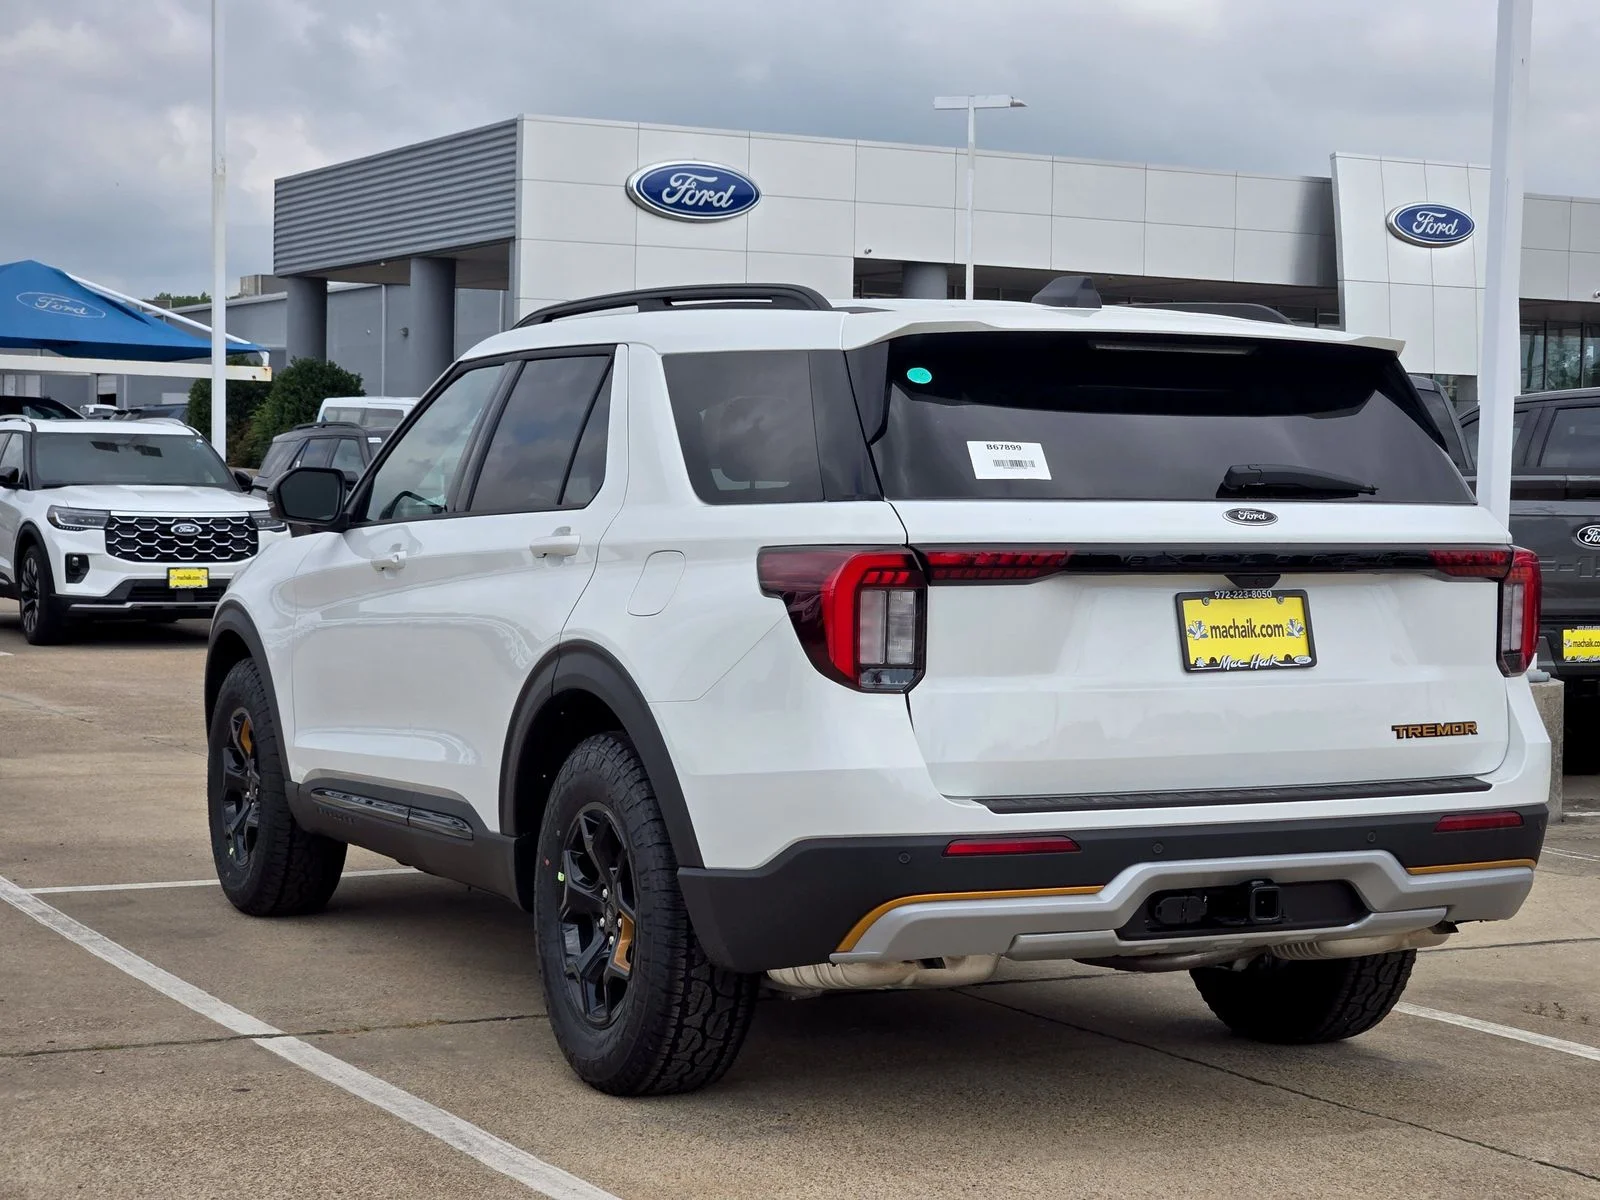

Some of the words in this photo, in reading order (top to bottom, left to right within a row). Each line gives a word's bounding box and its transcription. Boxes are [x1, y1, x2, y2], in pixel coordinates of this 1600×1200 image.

[661, 172, 736, 209] Ford
[1412, 210, 1459, 236] Ford
[34, 296, 88, 315] Ford
[986, 443, 1022, 451] B67899
[1237, 510, 1267, 520] Ford
[1214, 589, 1273, 599] 972-223-8050
[1210, 618, 1285, 639] machaik.com
[1219, 655, 1249, 671] Mac
[1250, 653, 1279, 669] Haik
[1391, 721, 1478, 739] TREMOR
